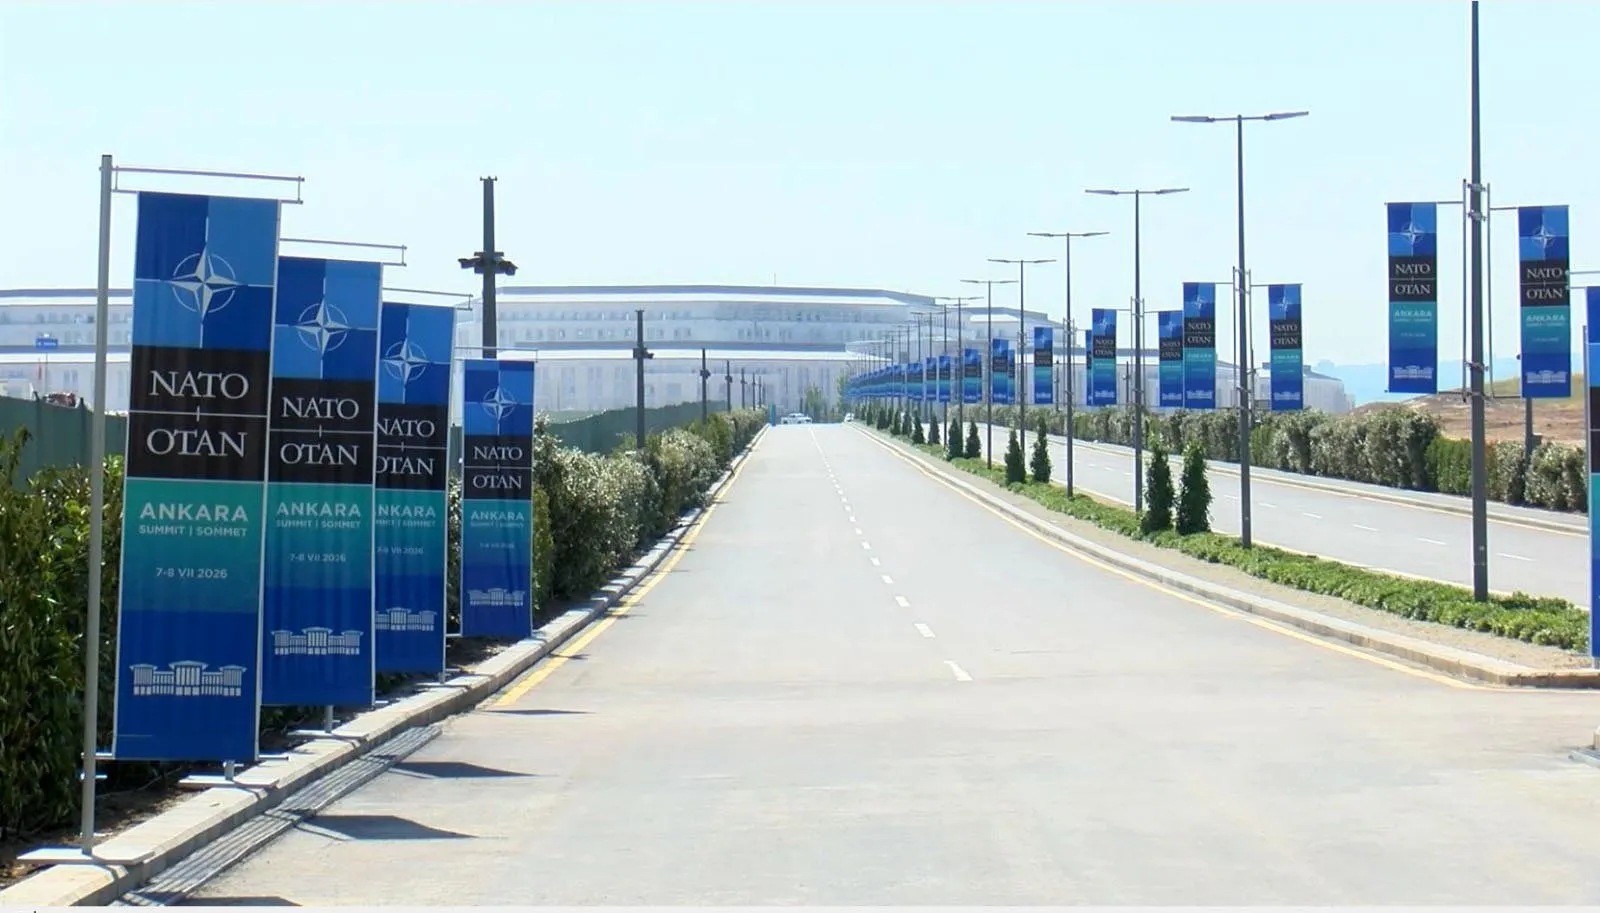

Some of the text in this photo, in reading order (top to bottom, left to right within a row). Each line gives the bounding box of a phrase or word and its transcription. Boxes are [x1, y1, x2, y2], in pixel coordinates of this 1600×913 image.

[1395, 263, 1431, 274] NATO
[1527, 267, 1563, 278] NATO
[1395, 284, 1431, 295] OTAN
[1526, 288, 1563, 299] OTAN
[149, 370, 249, 399] NATO
[281, 397, 359, 420] NATO
[147, 428, 248, 457] OTAN
[280, 443, 359, 466] OTAN
[473, 446, 523, 461] NATO
[473, 474, 522, 489] OTAN
[139, 502, 249, 521] ANKARA
[276, 502, 361, 517] ANKARA
[375, 504, 436, 518] NKARA
[471, 511, 525, 521] ANKARA
[138, 525, 186, 535] SUMMIT
[196, 526, 248, 537] SOMMET
[156, 567, 228, 579] 7-8 VII 2026
